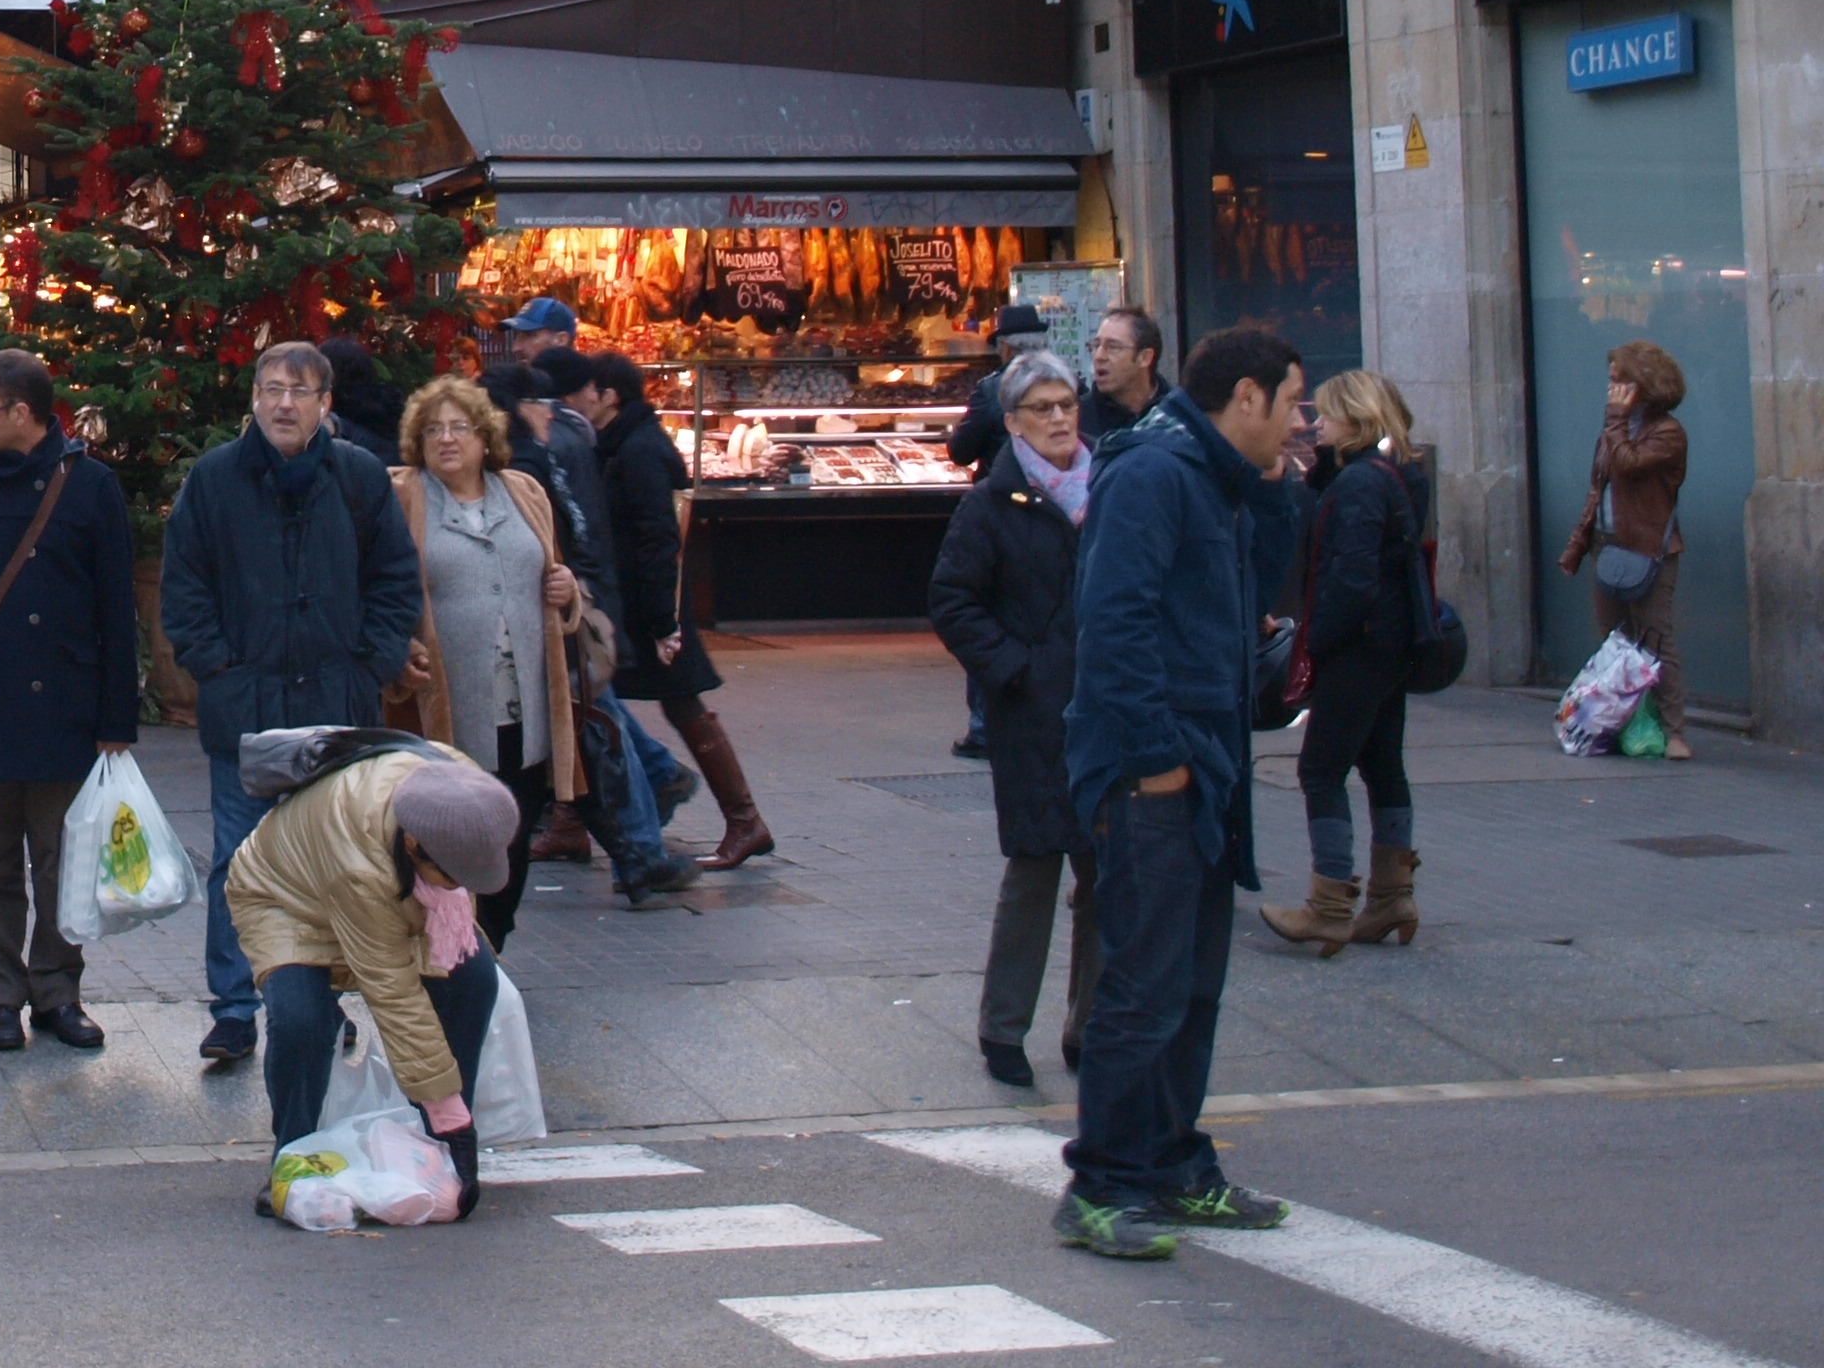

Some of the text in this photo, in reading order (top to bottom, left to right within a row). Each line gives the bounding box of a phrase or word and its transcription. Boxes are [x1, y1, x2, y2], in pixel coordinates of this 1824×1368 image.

[1569, 29, 1677, 78] CHANGE
[496, 134, 583, 152] JABUGO
[729, 194, 820, 219] Marcos
[716, 249, 779, 269] MALDONADO
[889, 235, 952, 259] JOSELITO
